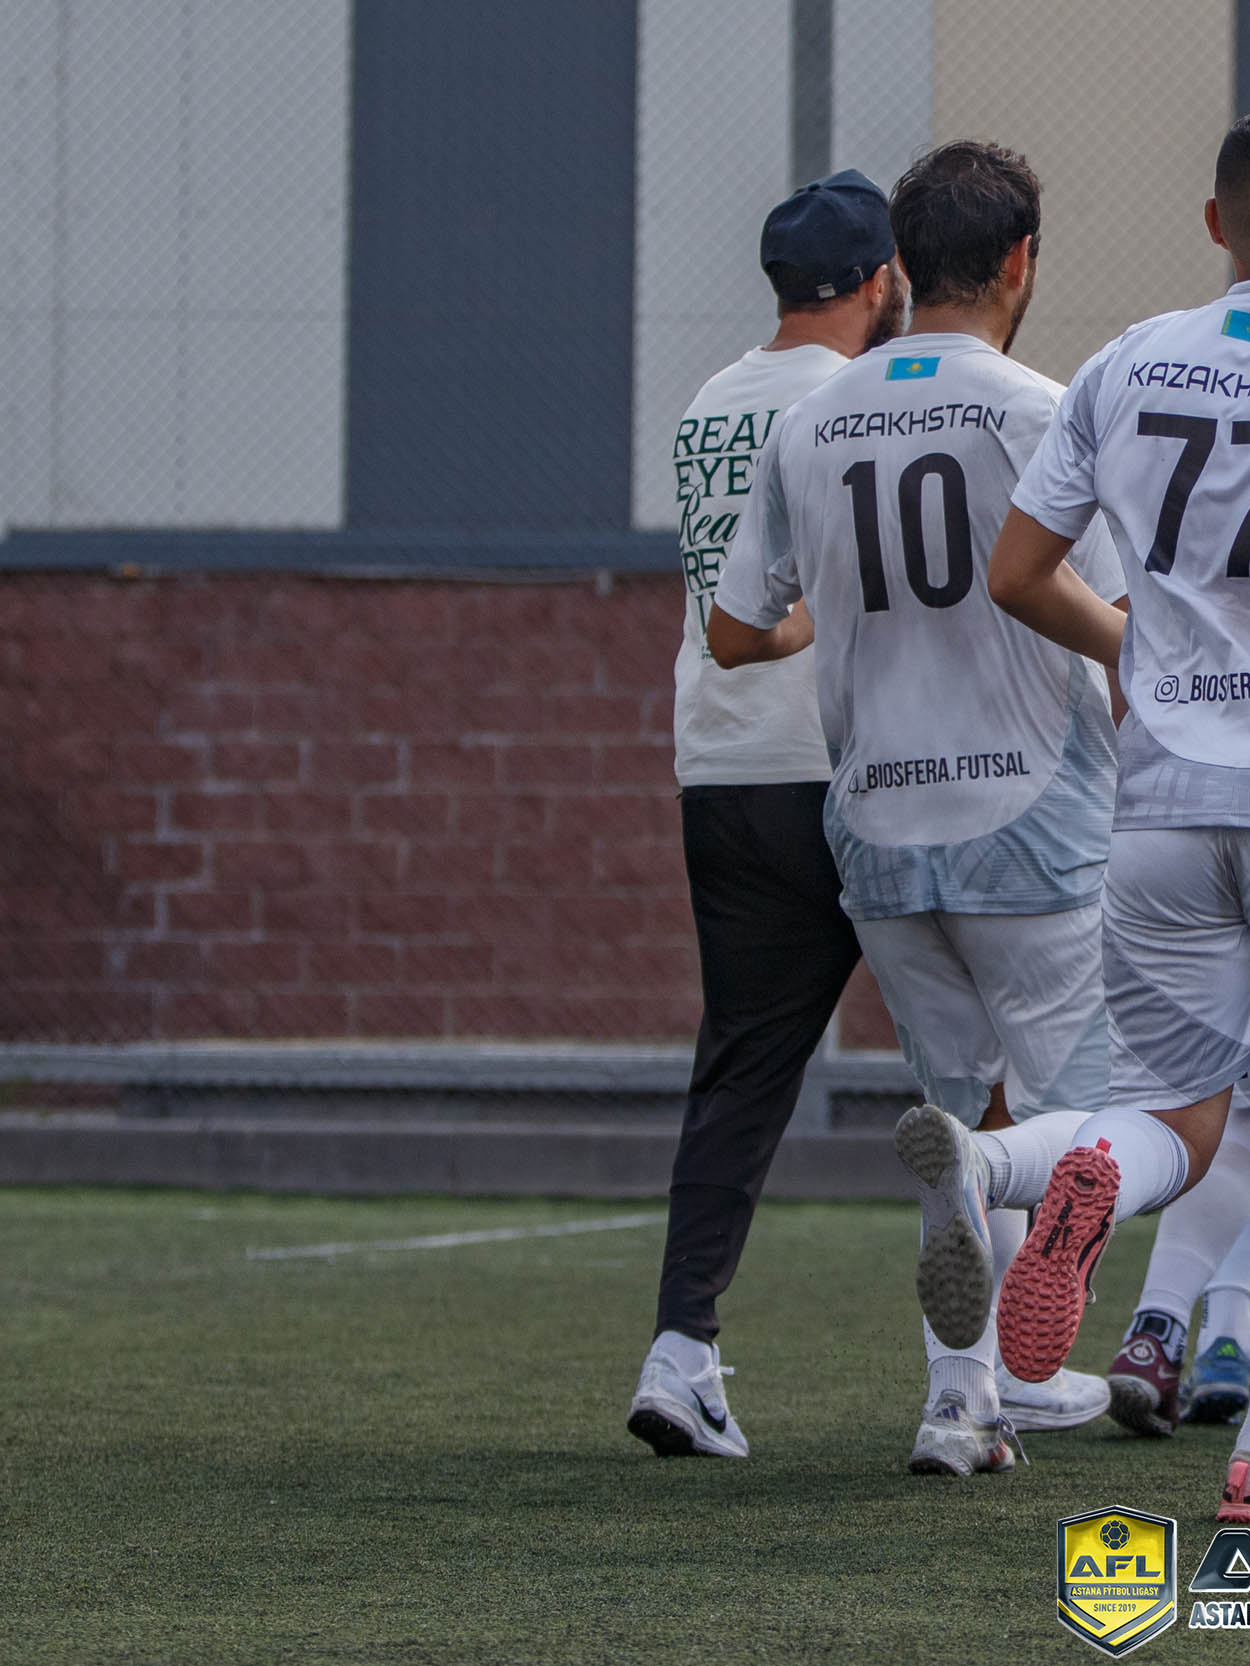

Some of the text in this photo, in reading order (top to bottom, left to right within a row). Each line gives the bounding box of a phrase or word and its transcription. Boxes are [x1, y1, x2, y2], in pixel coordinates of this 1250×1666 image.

[815, 403, 1007, 447] KAZAKHSTAN
[674, 453, 760, 502] EYE
[841, 452, 975, 613] 10
